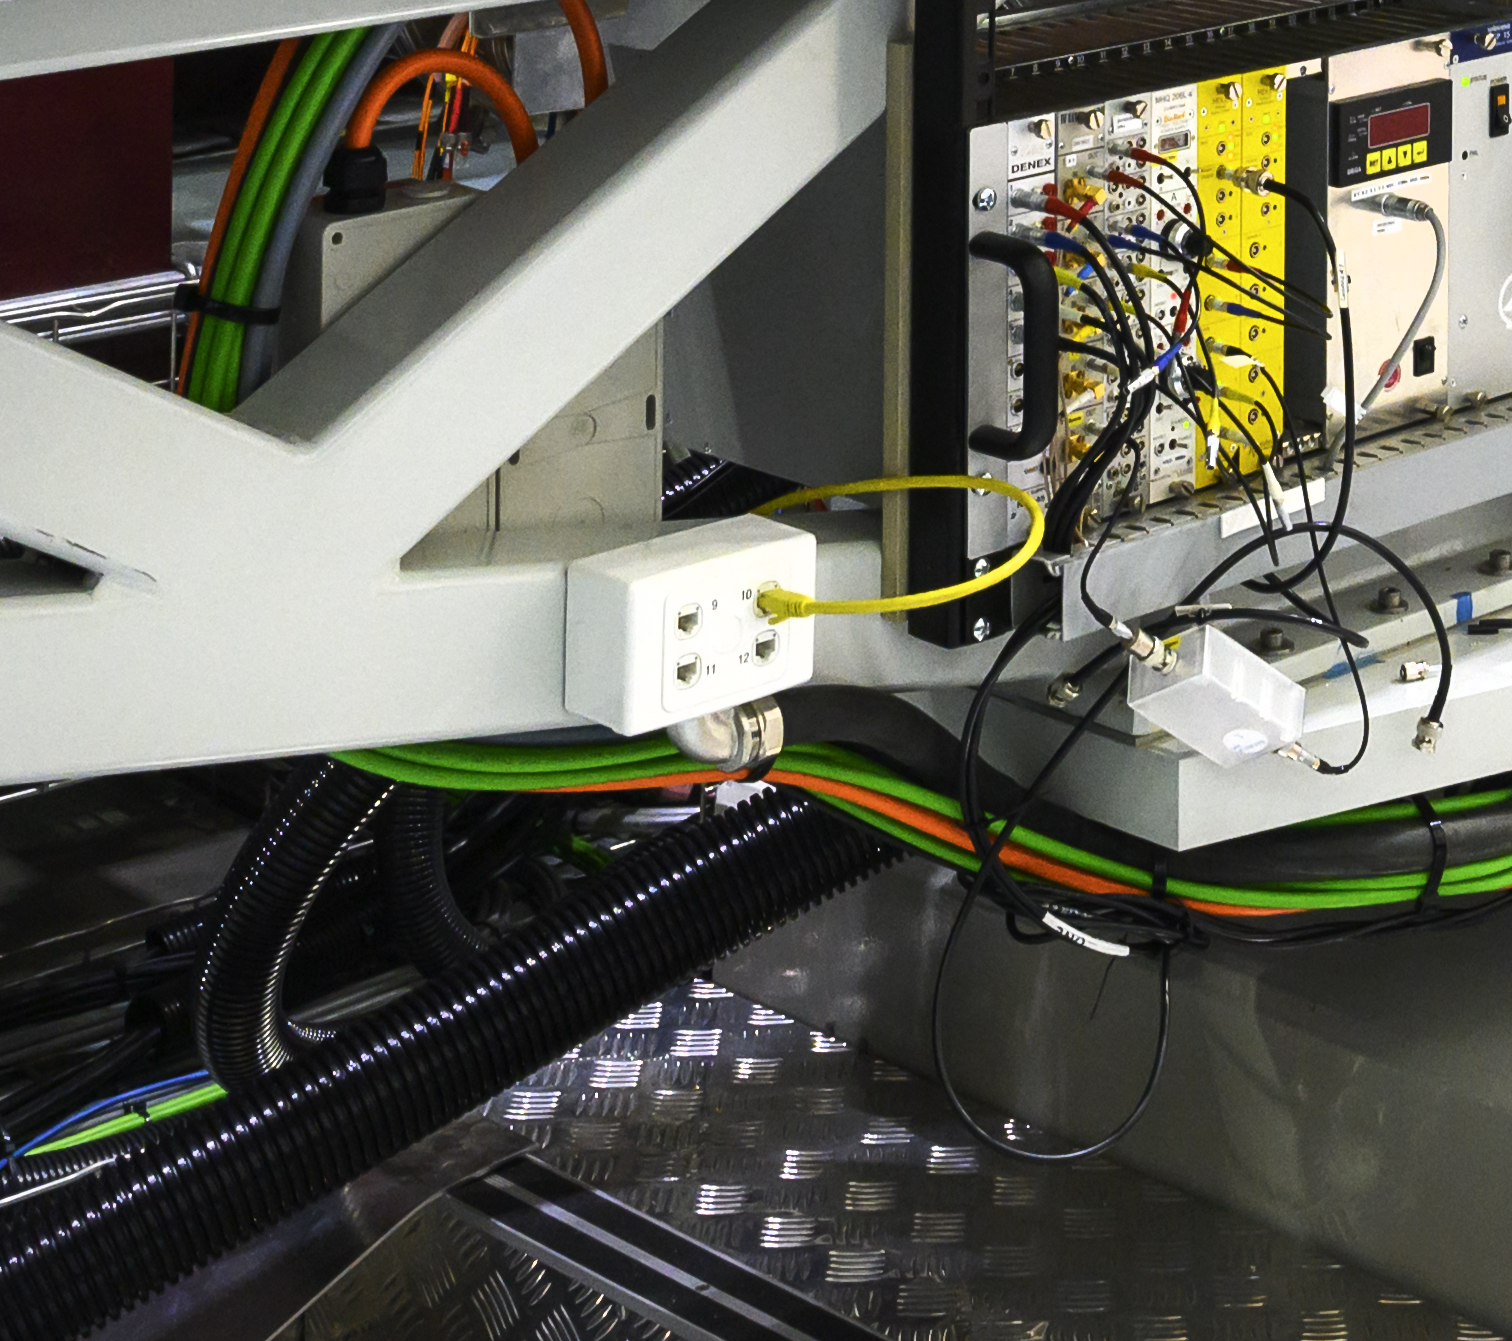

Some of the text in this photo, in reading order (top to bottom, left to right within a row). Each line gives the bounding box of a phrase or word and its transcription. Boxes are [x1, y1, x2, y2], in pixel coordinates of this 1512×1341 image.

[1011, 157, 1052, 174] DENEX
[741, 589, 753, 601] 10
[711, 599, 718, 610] 9
[738, 652, 750, 664] 12
[706, 664, 716, 676] 11
